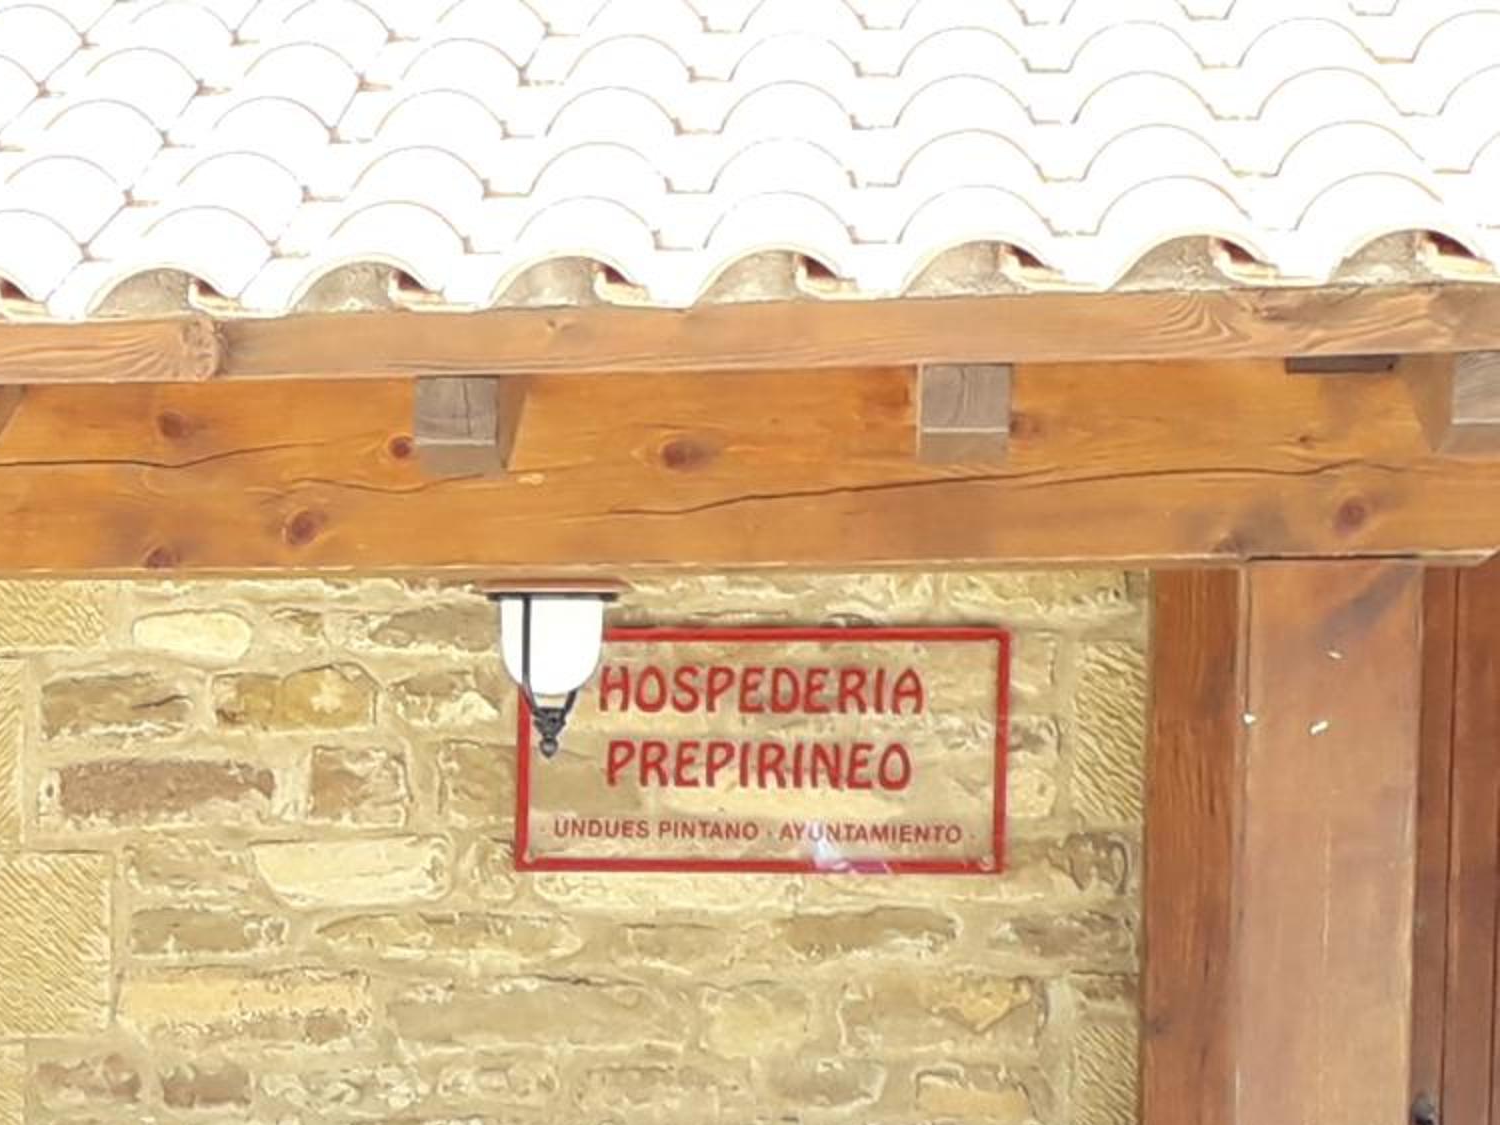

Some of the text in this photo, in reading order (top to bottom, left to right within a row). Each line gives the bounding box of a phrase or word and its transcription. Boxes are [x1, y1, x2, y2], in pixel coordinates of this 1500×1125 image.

[599, 665, 923, 715] HOSPEDERIA
[606, 740, 911, 791] PREPIRINEO
[554, 819, 962, 843] UNDUES PINTANO AYUNTAMIENTO
